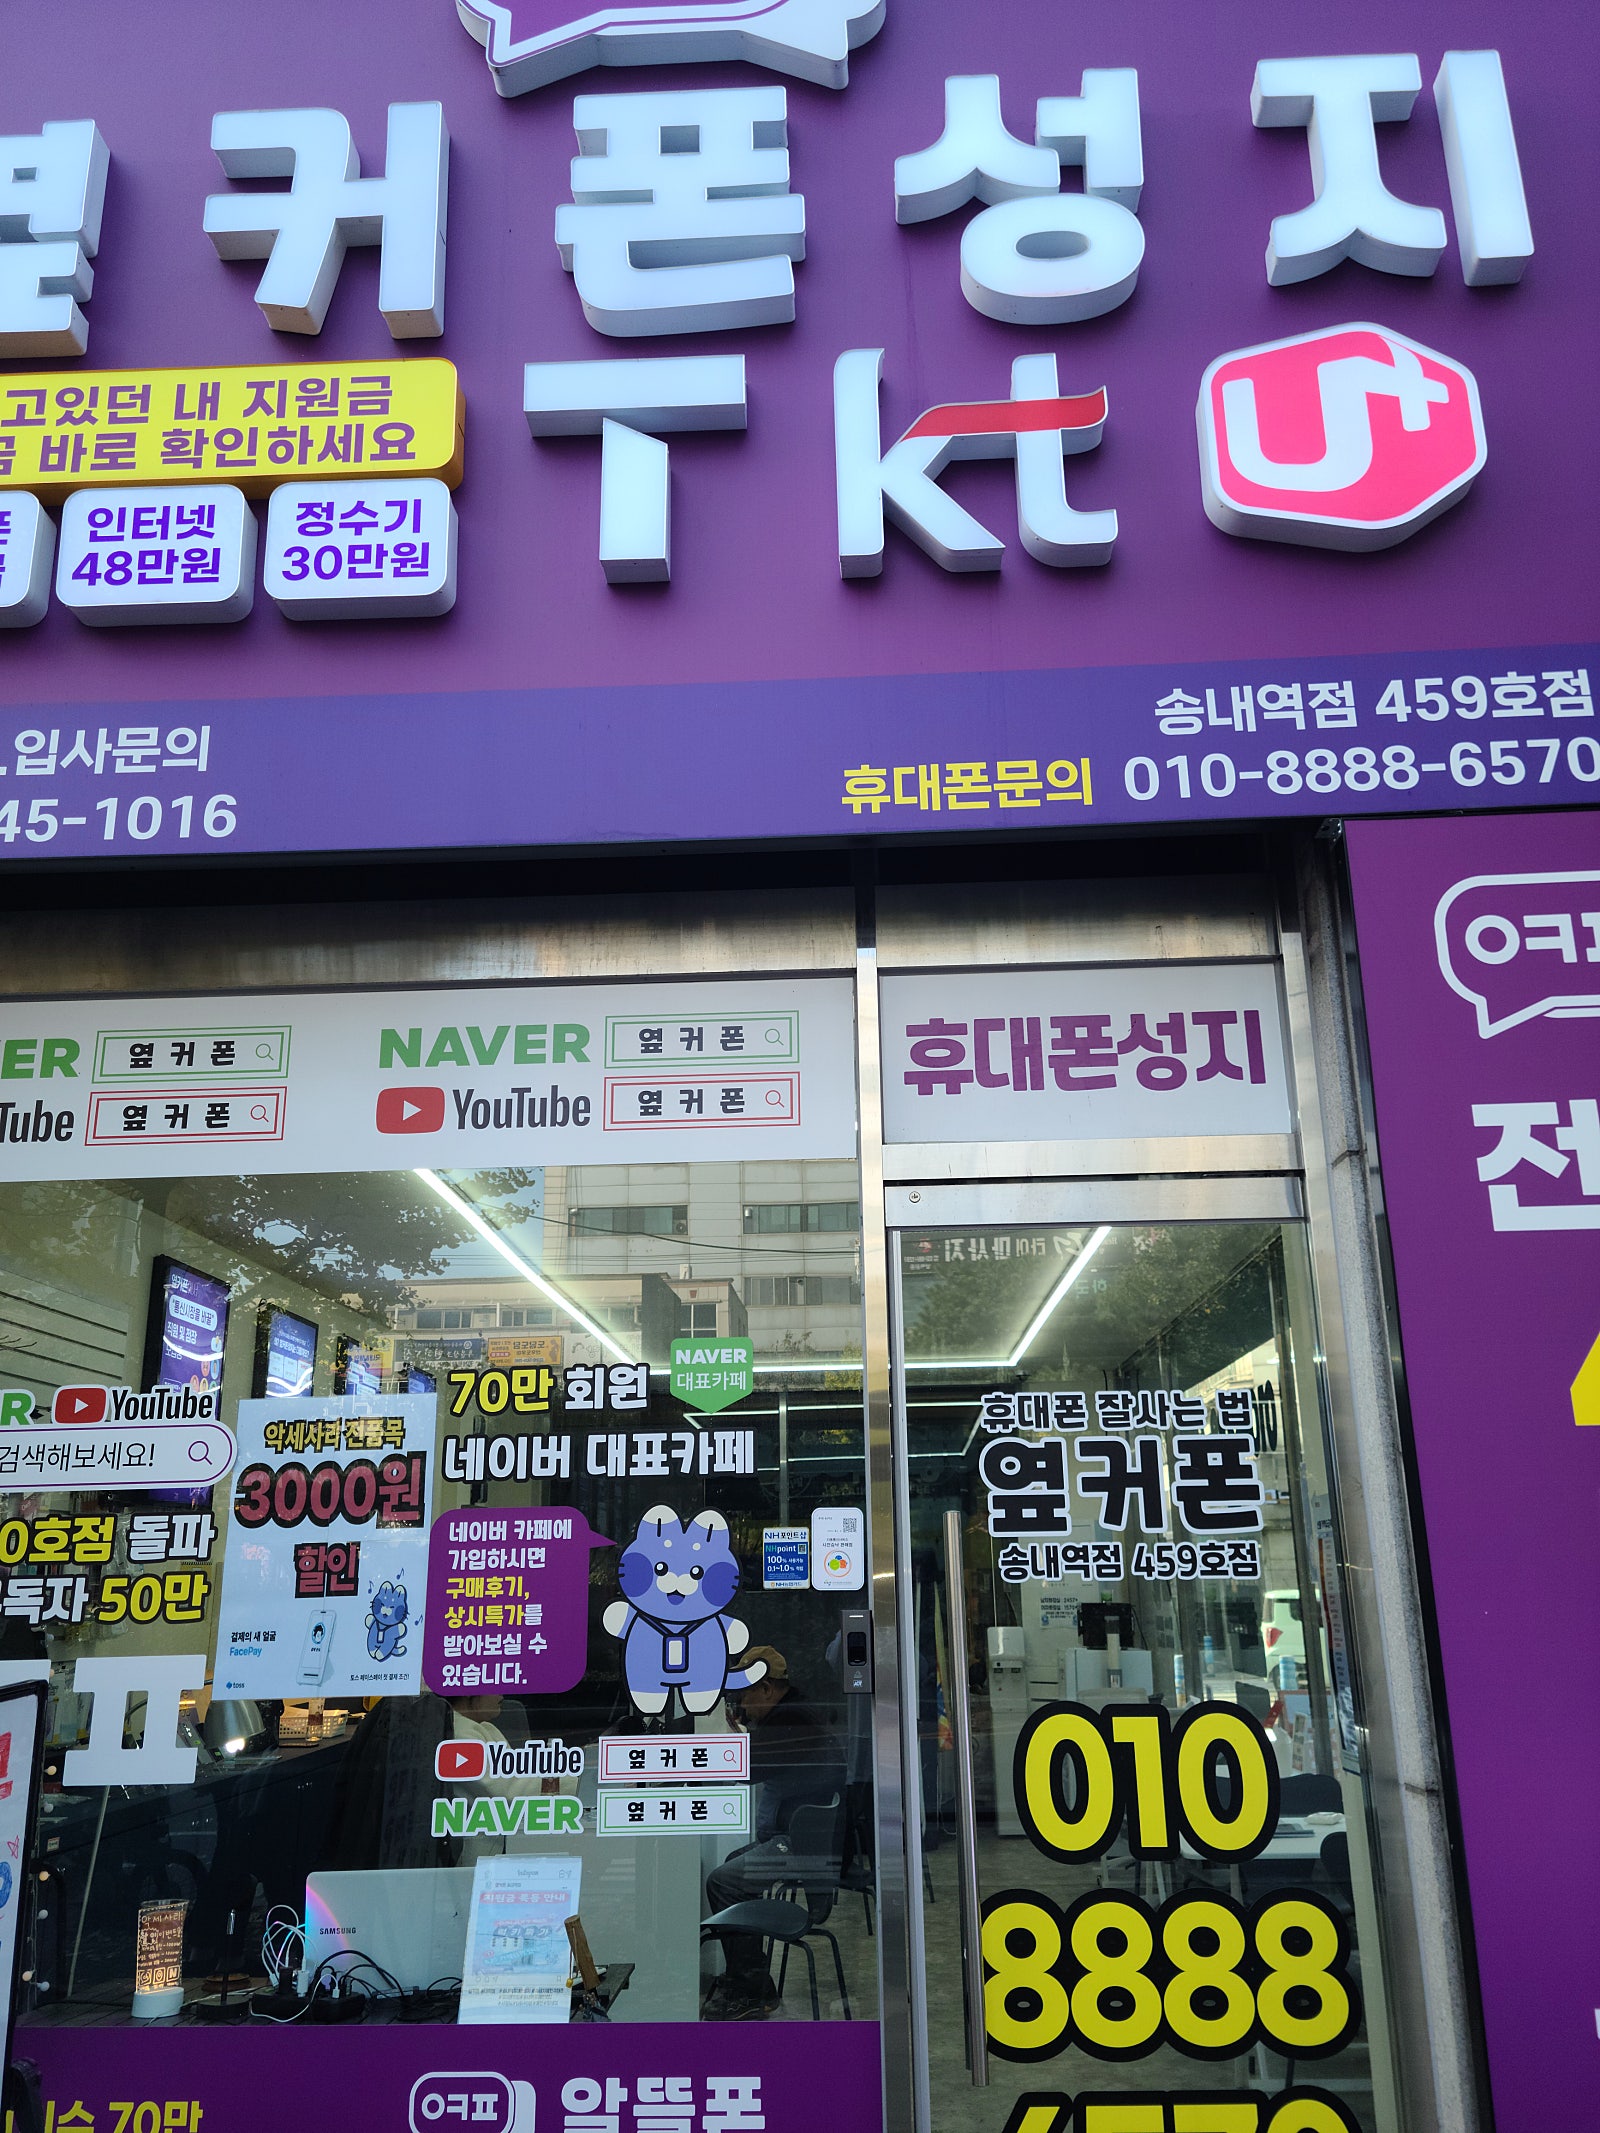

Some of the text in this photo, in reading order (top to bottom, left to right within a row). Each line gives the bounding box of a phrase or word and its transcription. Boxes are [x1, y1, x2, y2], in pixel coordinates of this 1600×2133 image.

[1, 373, 394, 428] 고있던 내 지원금
[39, 430, 138, 473] 바로
[160, 422, 418, 469] 확인하세요
[833, 348, 1118, 578] kt
[86, 503, 217, 542] 인터넷
[296, 496, 423, 537] 정수기
[71, 546, 222, 587] 48만원
[281, 540, 430, 581] 30만원
[1155, 669, 1592, 736] 송내역점 459호점
[842, 737, 1600, 814] 휴대폰문의 010-8888-6570
[0, 794, 237, 842] 45-1016
[378, 1023, 591, 1069] NAVER
[903, 1009, 1267, 1095] 휴대폰성지
[452, 1086, 591, 1130] YouTube
[676, 1348, 747, 1365] NAVER
[450, 1366, 648, 1414] 70만 회원
[676, 1371, 747, 1392] 대표카페
[112, 1387, 213, 1421] YouTube
[982, 1393, 1087, 1432] 휴대폰
[1096, 1392, 1206, 1430] 잘사는
[1217, 1391, 1251, 1428] 법
[264, 1418, 404, 1451] 악세사리 전품목
[0, 1442, 155, 1472] 검색해보세요!
[445, 1431, 755, 1480] 네이버 대표카페
[236, 1458, 422, 1523] 3000원
[983, 1438, 1261, 1533] 옆커폰
[0, 1514, 215, 1563] 0호점 돌파
[449, 1518, 572, 1541] 네이버 카페에
[297, 1545, 357, 1595] 할인
[449, 1548, 546, 1570] 가입하시면
[1001, 1542, 1259, 1581] 송내역점 459호점
[0, 1575, 208, 1624] 독자 50만
[446, 1577, 530, 1600] 구매후기,
[444, 1604, 543, 1627] 상시특가를
[229, 1647, 263, 1658] FacePay
[231, 1630, 277, 1643] 결제의 새 얼굴
[442, 1632, 548, 1657] 받아보실 수
[441, 1662, 528, 1687] 있습니다.
[489, 1741, 582, 1776] YouTube
[1025, 1713, 1269, 1851] 010
[434, 1798, 582, 1834] NAVER
[319, 1927, 357, 1935] SAMSUNG
[982, 1901, 1350, 2048] 8888
[561, 2076, 765, 2133] 알뜰폰
